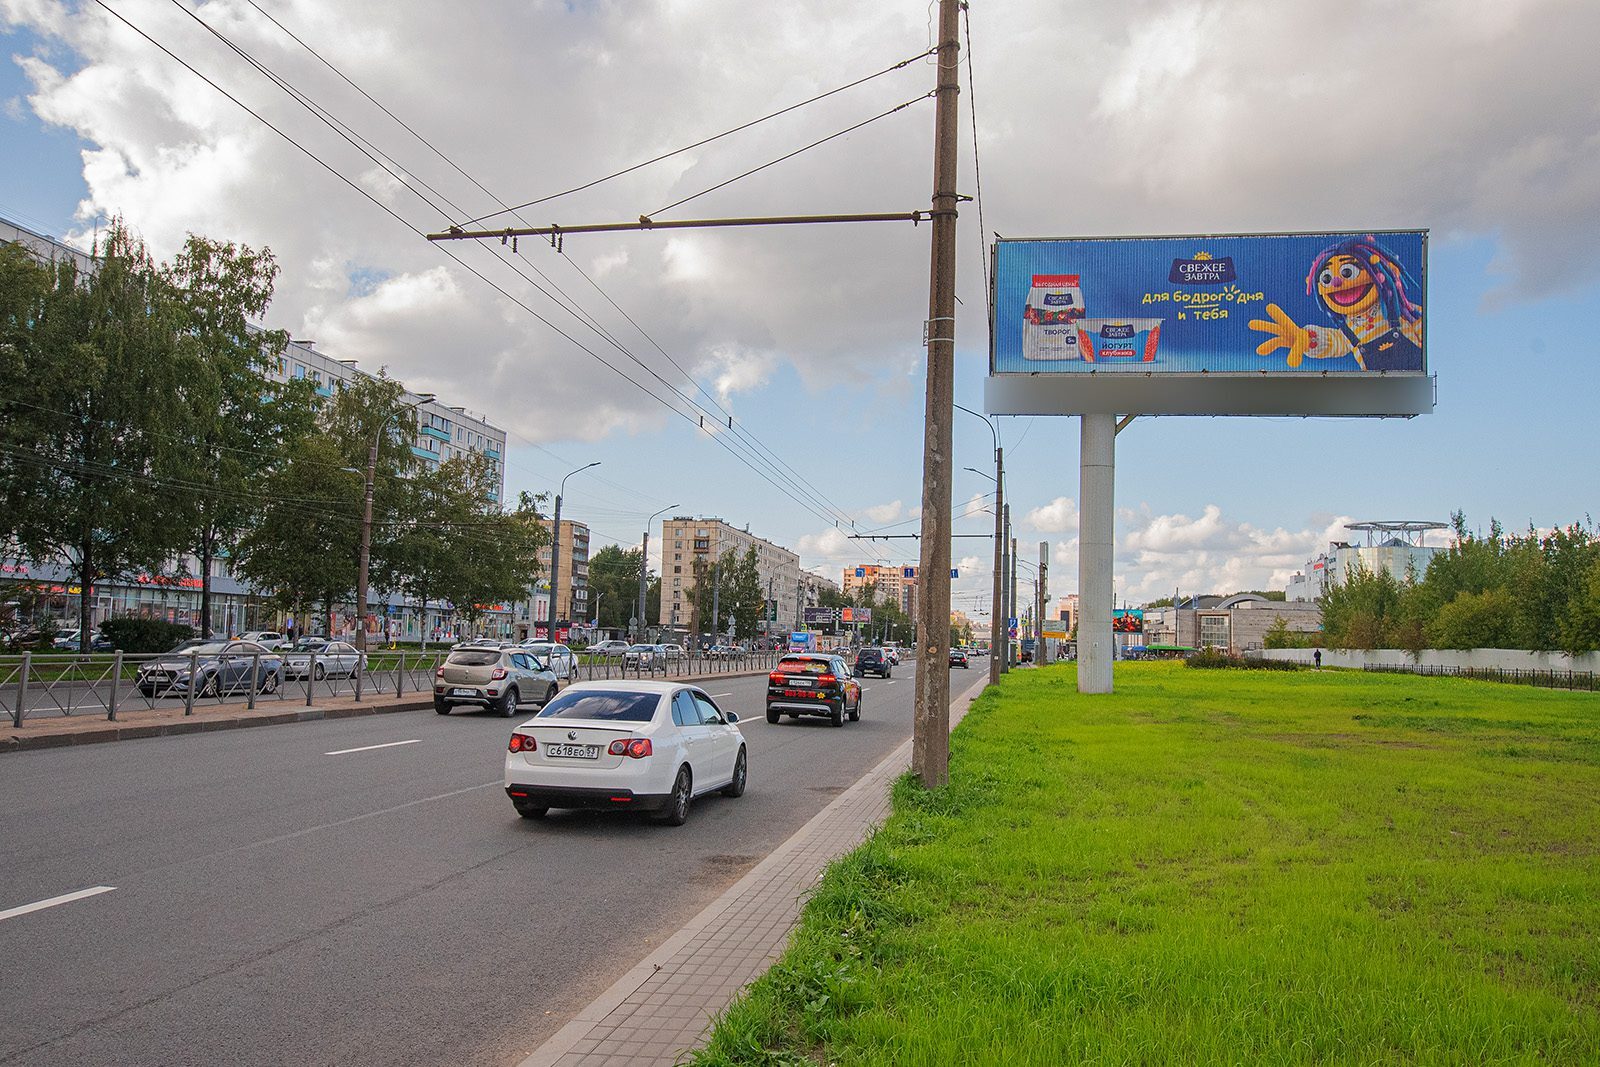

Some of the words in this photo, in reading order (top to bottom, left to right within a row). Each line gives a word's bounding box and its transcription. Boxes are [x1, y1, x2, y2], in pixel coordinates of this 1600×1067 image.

[1179, 263, 1226, 273] СВЕЖЕЕ
[1184, 272, 1220, 281] ЗАВТРА
[1142, 292, 1170, 304] для
[1173, 290, 1234, 304] бодрого
[1236, 291, 1264, 304] дня
[1178, 311, 1186, 320] и
[1194, 308, 1228, 320] тебя
[1102, 341, 1133, 349] ЙОГУРТ
[1101, 349, 1133, 357] клубника
